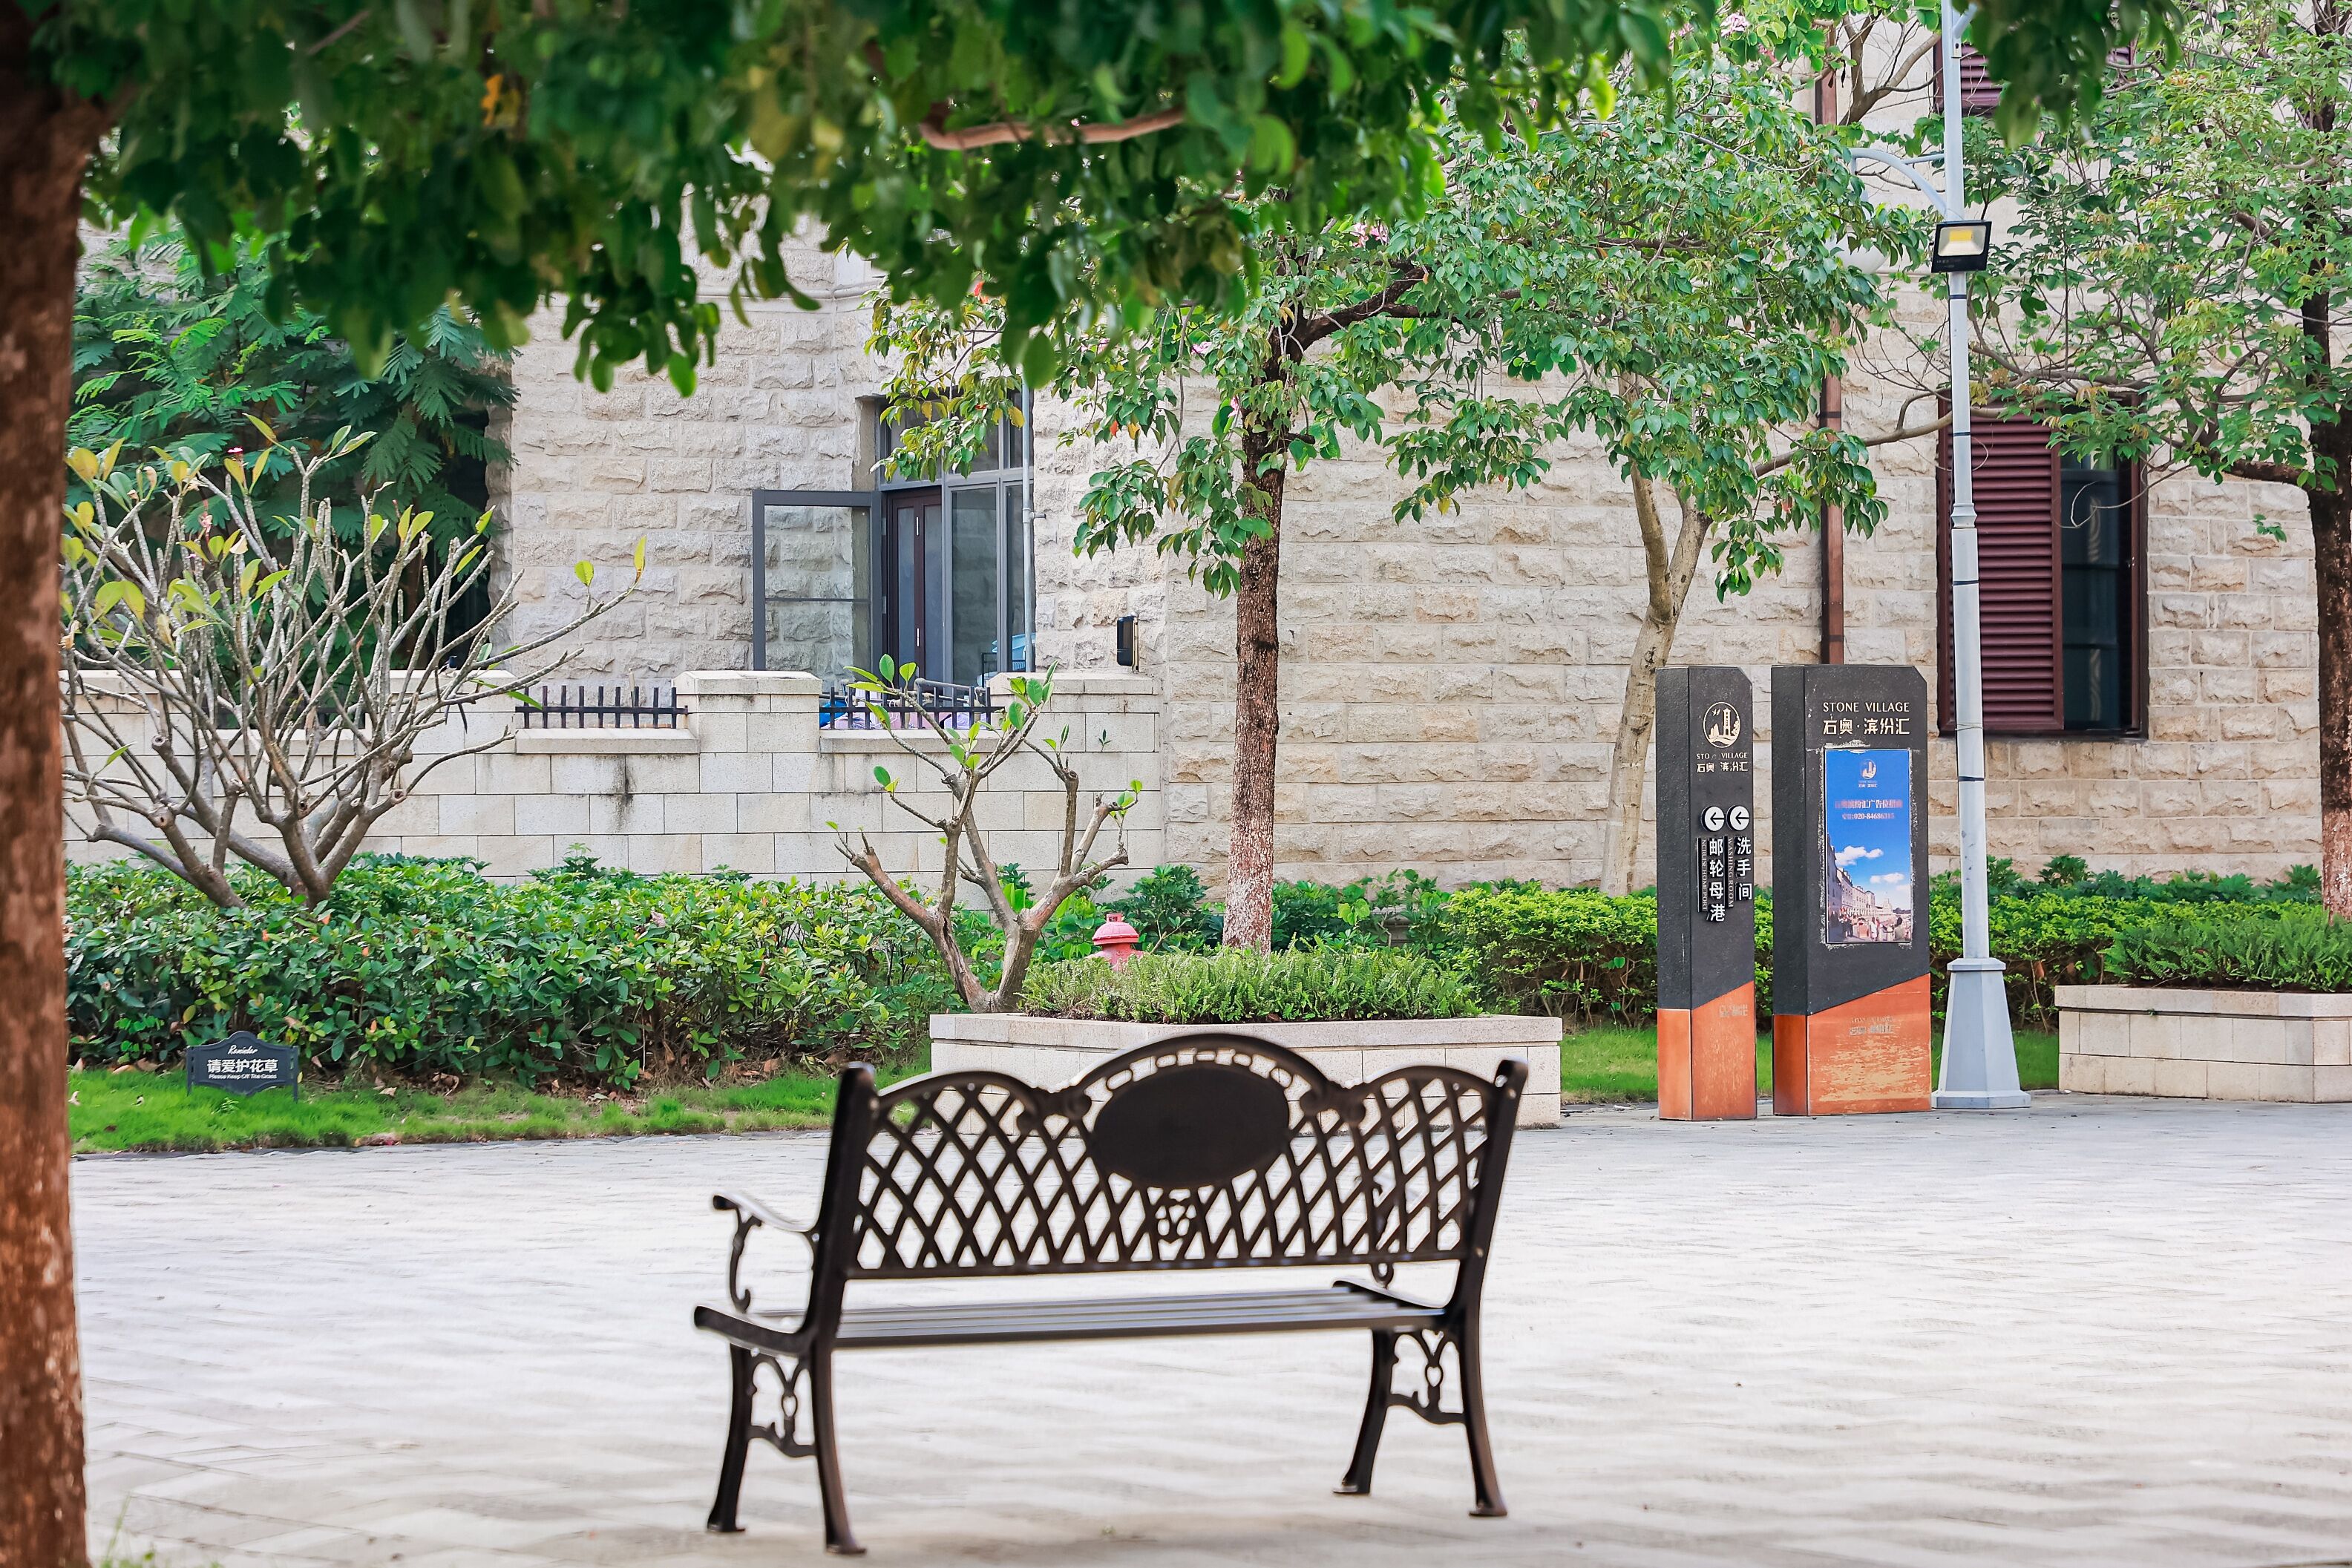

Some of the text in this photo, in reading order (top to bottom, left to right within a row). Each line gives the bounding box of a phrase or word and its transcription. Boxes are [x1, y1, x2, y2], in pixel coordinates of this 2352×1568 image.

[1823, 702, 1910, 712] STONE VILLAGE
[1709, 838, 1726, 922] 邮轮母港
[1737, 836, 1752, 901] 洗手间
[206, 1058, 278, 1073] 请爱护花草
